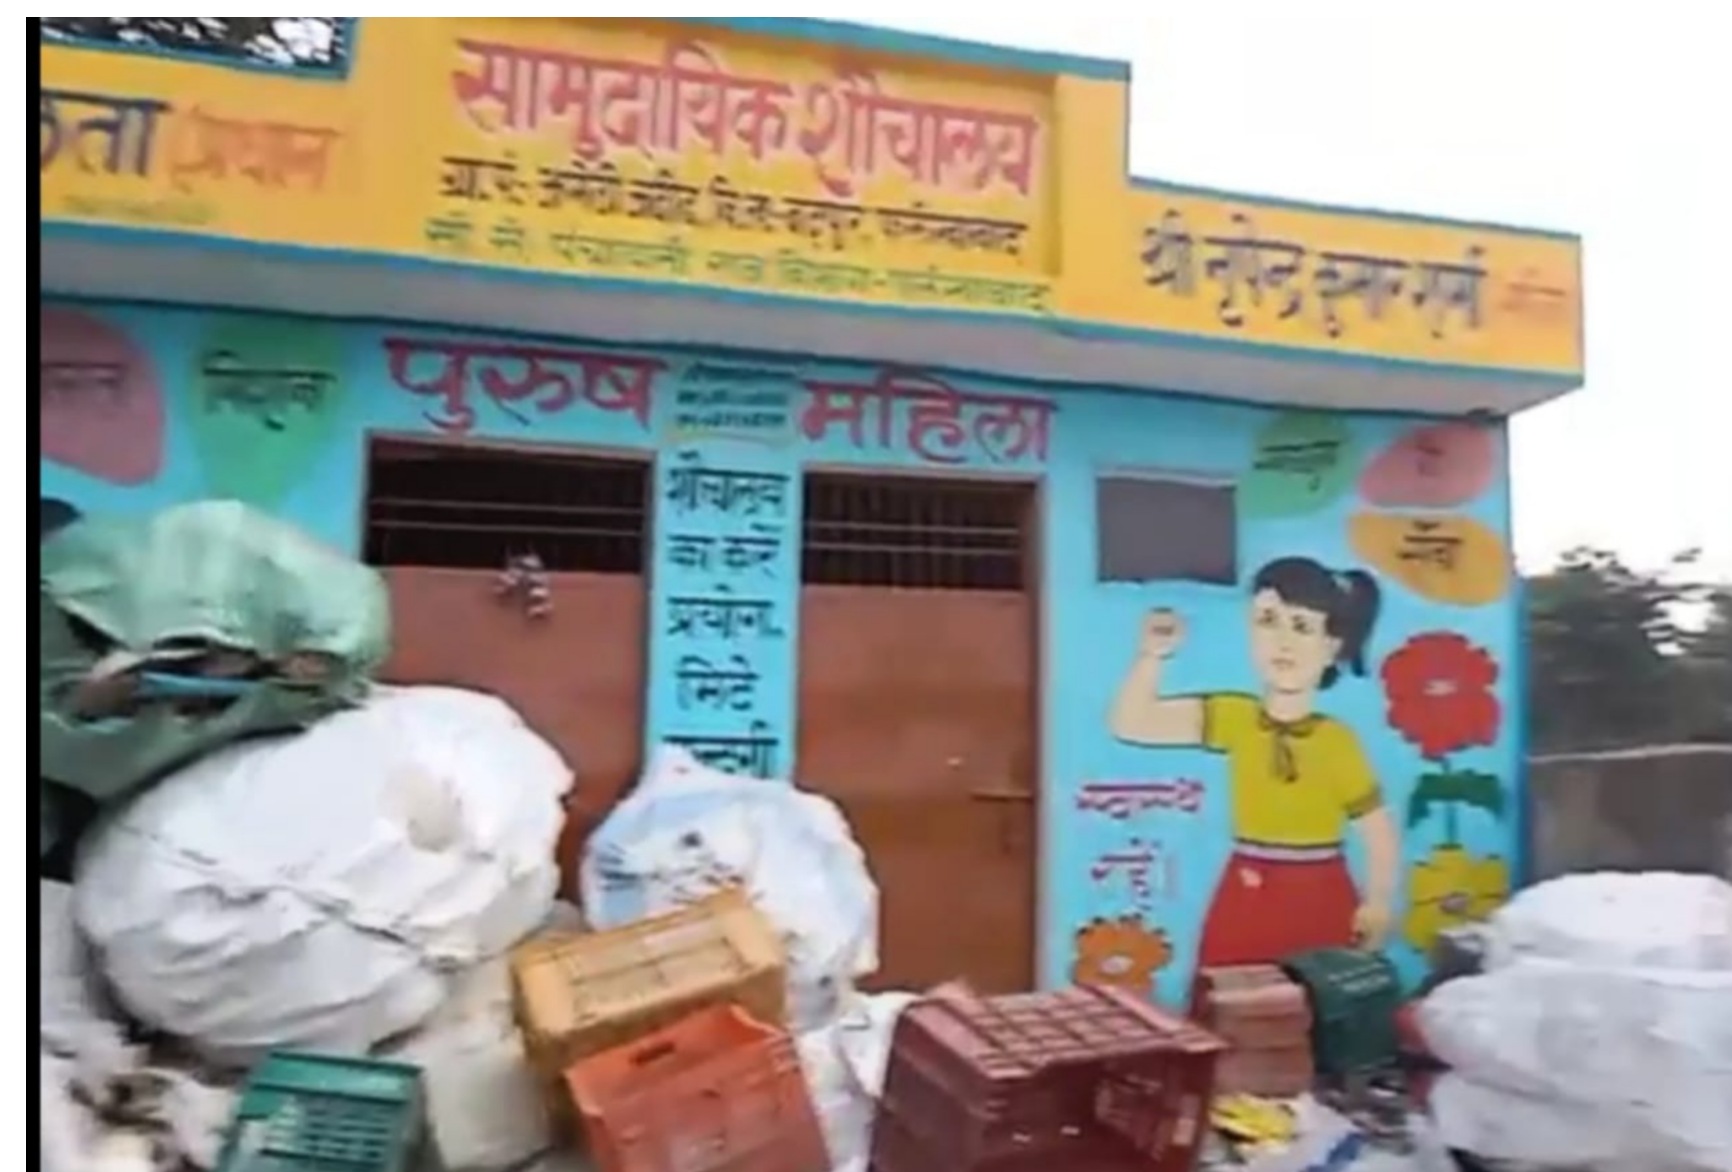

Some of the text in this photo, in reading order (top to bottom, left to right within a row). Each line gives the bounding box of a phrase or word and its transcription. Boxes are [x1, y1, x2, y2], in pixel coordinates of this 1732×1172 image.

[450, 37, 795, 160] सामुदायिक
[800, 65, 1039, 198] शौचालय
[382, 336, 674, 433] पुरुष
[799, 364, 1059, 463] महिला
